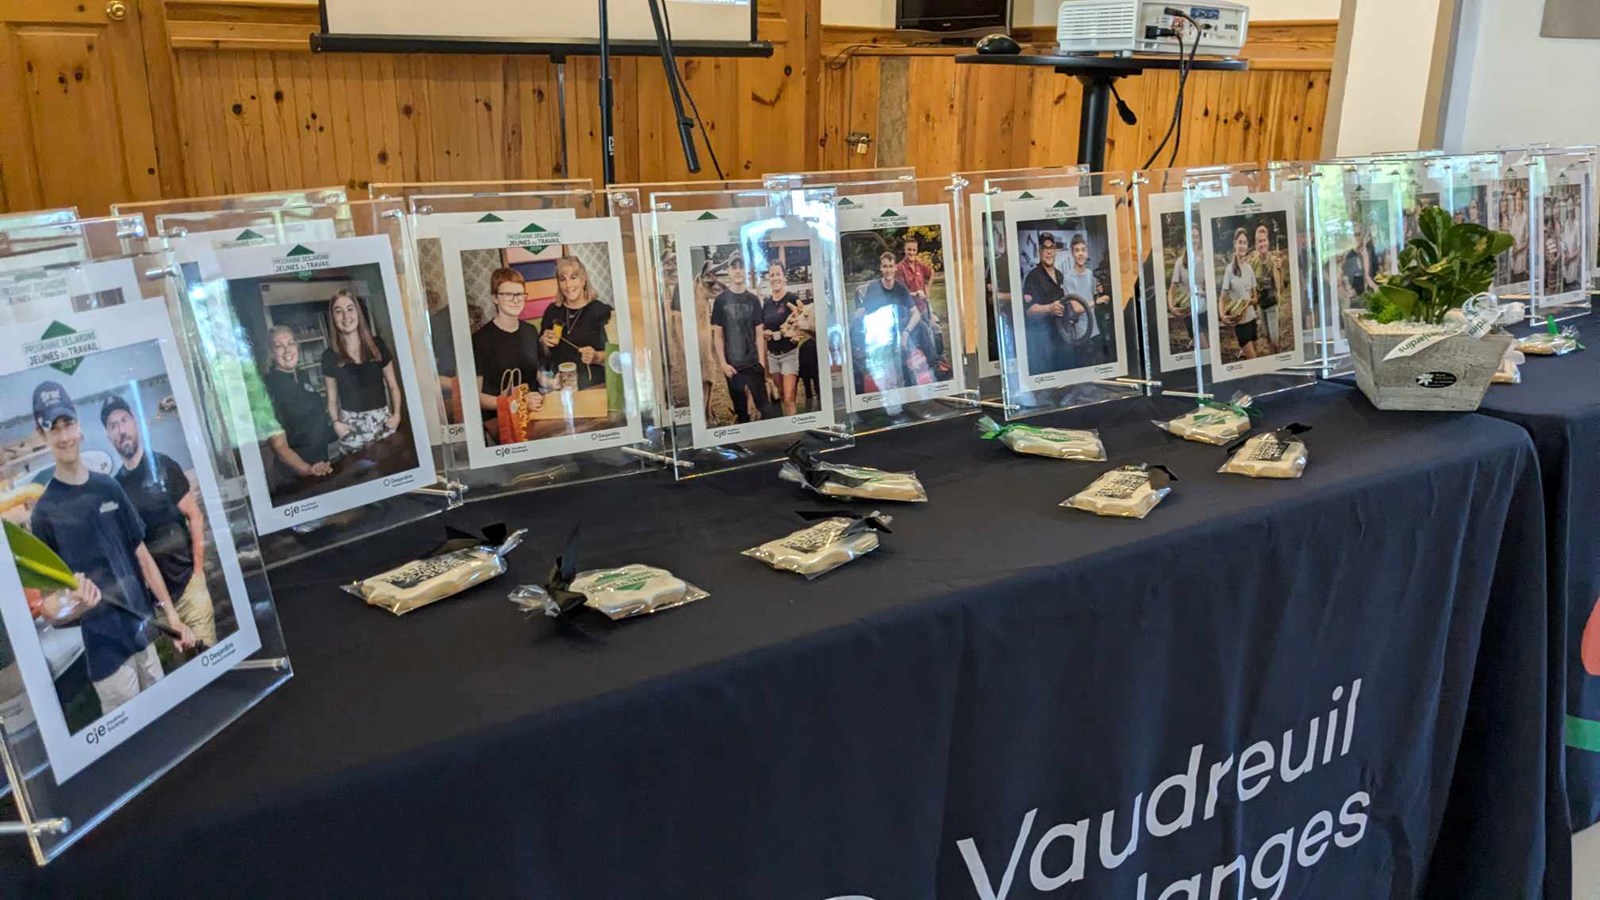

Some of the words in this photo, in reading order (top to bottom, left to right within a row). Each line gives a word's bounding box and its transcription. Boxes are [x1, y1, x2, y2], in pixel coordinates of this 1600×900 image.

[275, 263, 299, 272] JEUNES
[306, 260, 331, 268] TRAVAIL
[29, 350, 60, 366] JEUNES
[68, 341, 99, 356] TRAVAIL
[495, 447, 511, 457] cje
[284, 505, 300, 518] cje
[86, 724, 106, 745] cje
[957, 678, 1362, 900] Vaudreuil
